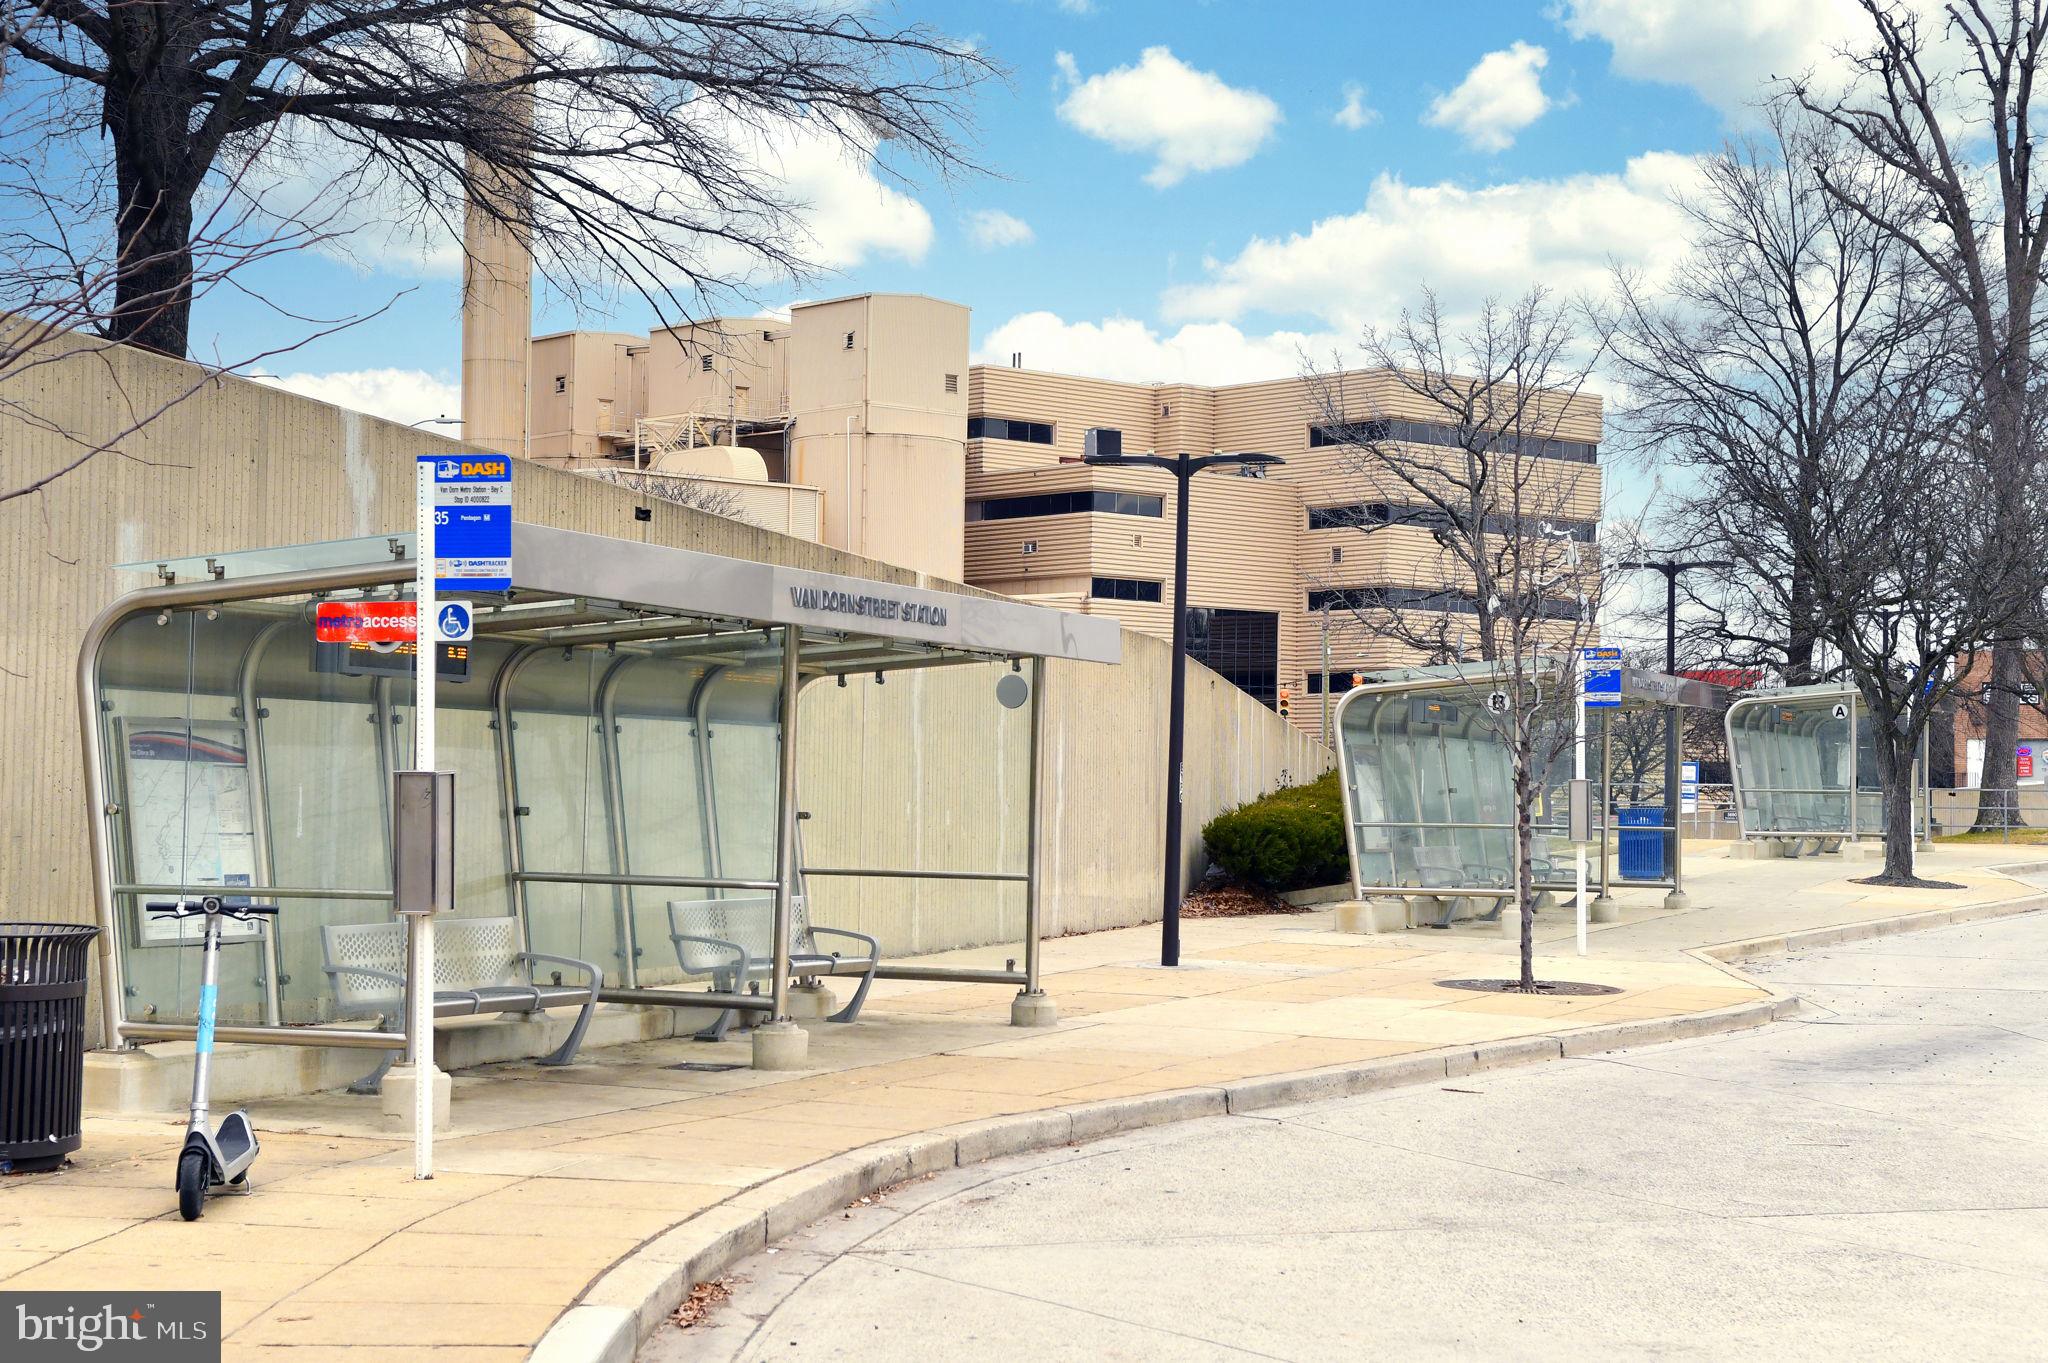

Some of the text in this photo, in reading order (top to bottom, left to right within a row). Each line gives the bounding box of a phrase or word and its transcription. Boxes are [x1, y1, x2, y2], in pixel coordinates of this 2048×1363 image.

[461, 462, 505, 475] DASH
[454, 496, 463, 504] Stop
[434, 511, 449, 525] 35
[790, 586, 818, 610] VAN
[855, 595, 901, 620] STREET
[901, 601, 948, 627] STATION
[1835, 706, 1845, 717] A
